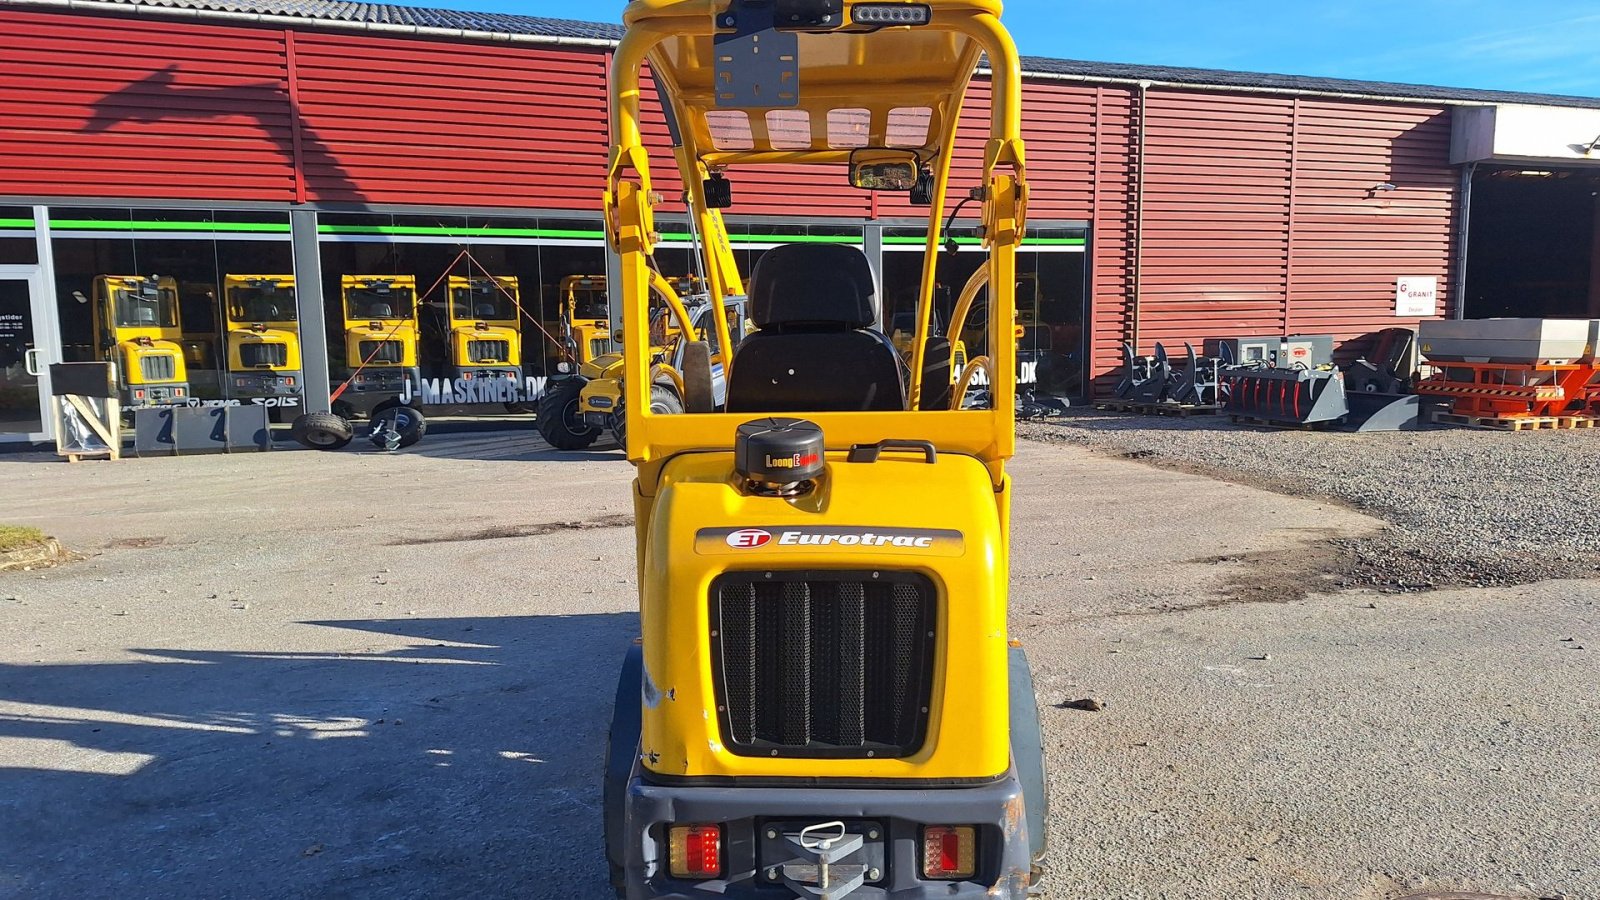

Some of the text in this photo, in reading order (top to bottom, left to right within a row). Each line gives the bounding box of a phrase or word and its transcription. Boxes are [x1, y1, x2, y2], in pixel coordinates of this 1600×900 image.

[399, 376, 548, 405] J-MASKINER.DK
[731, 530, 933, 548] ET Eurotrac
